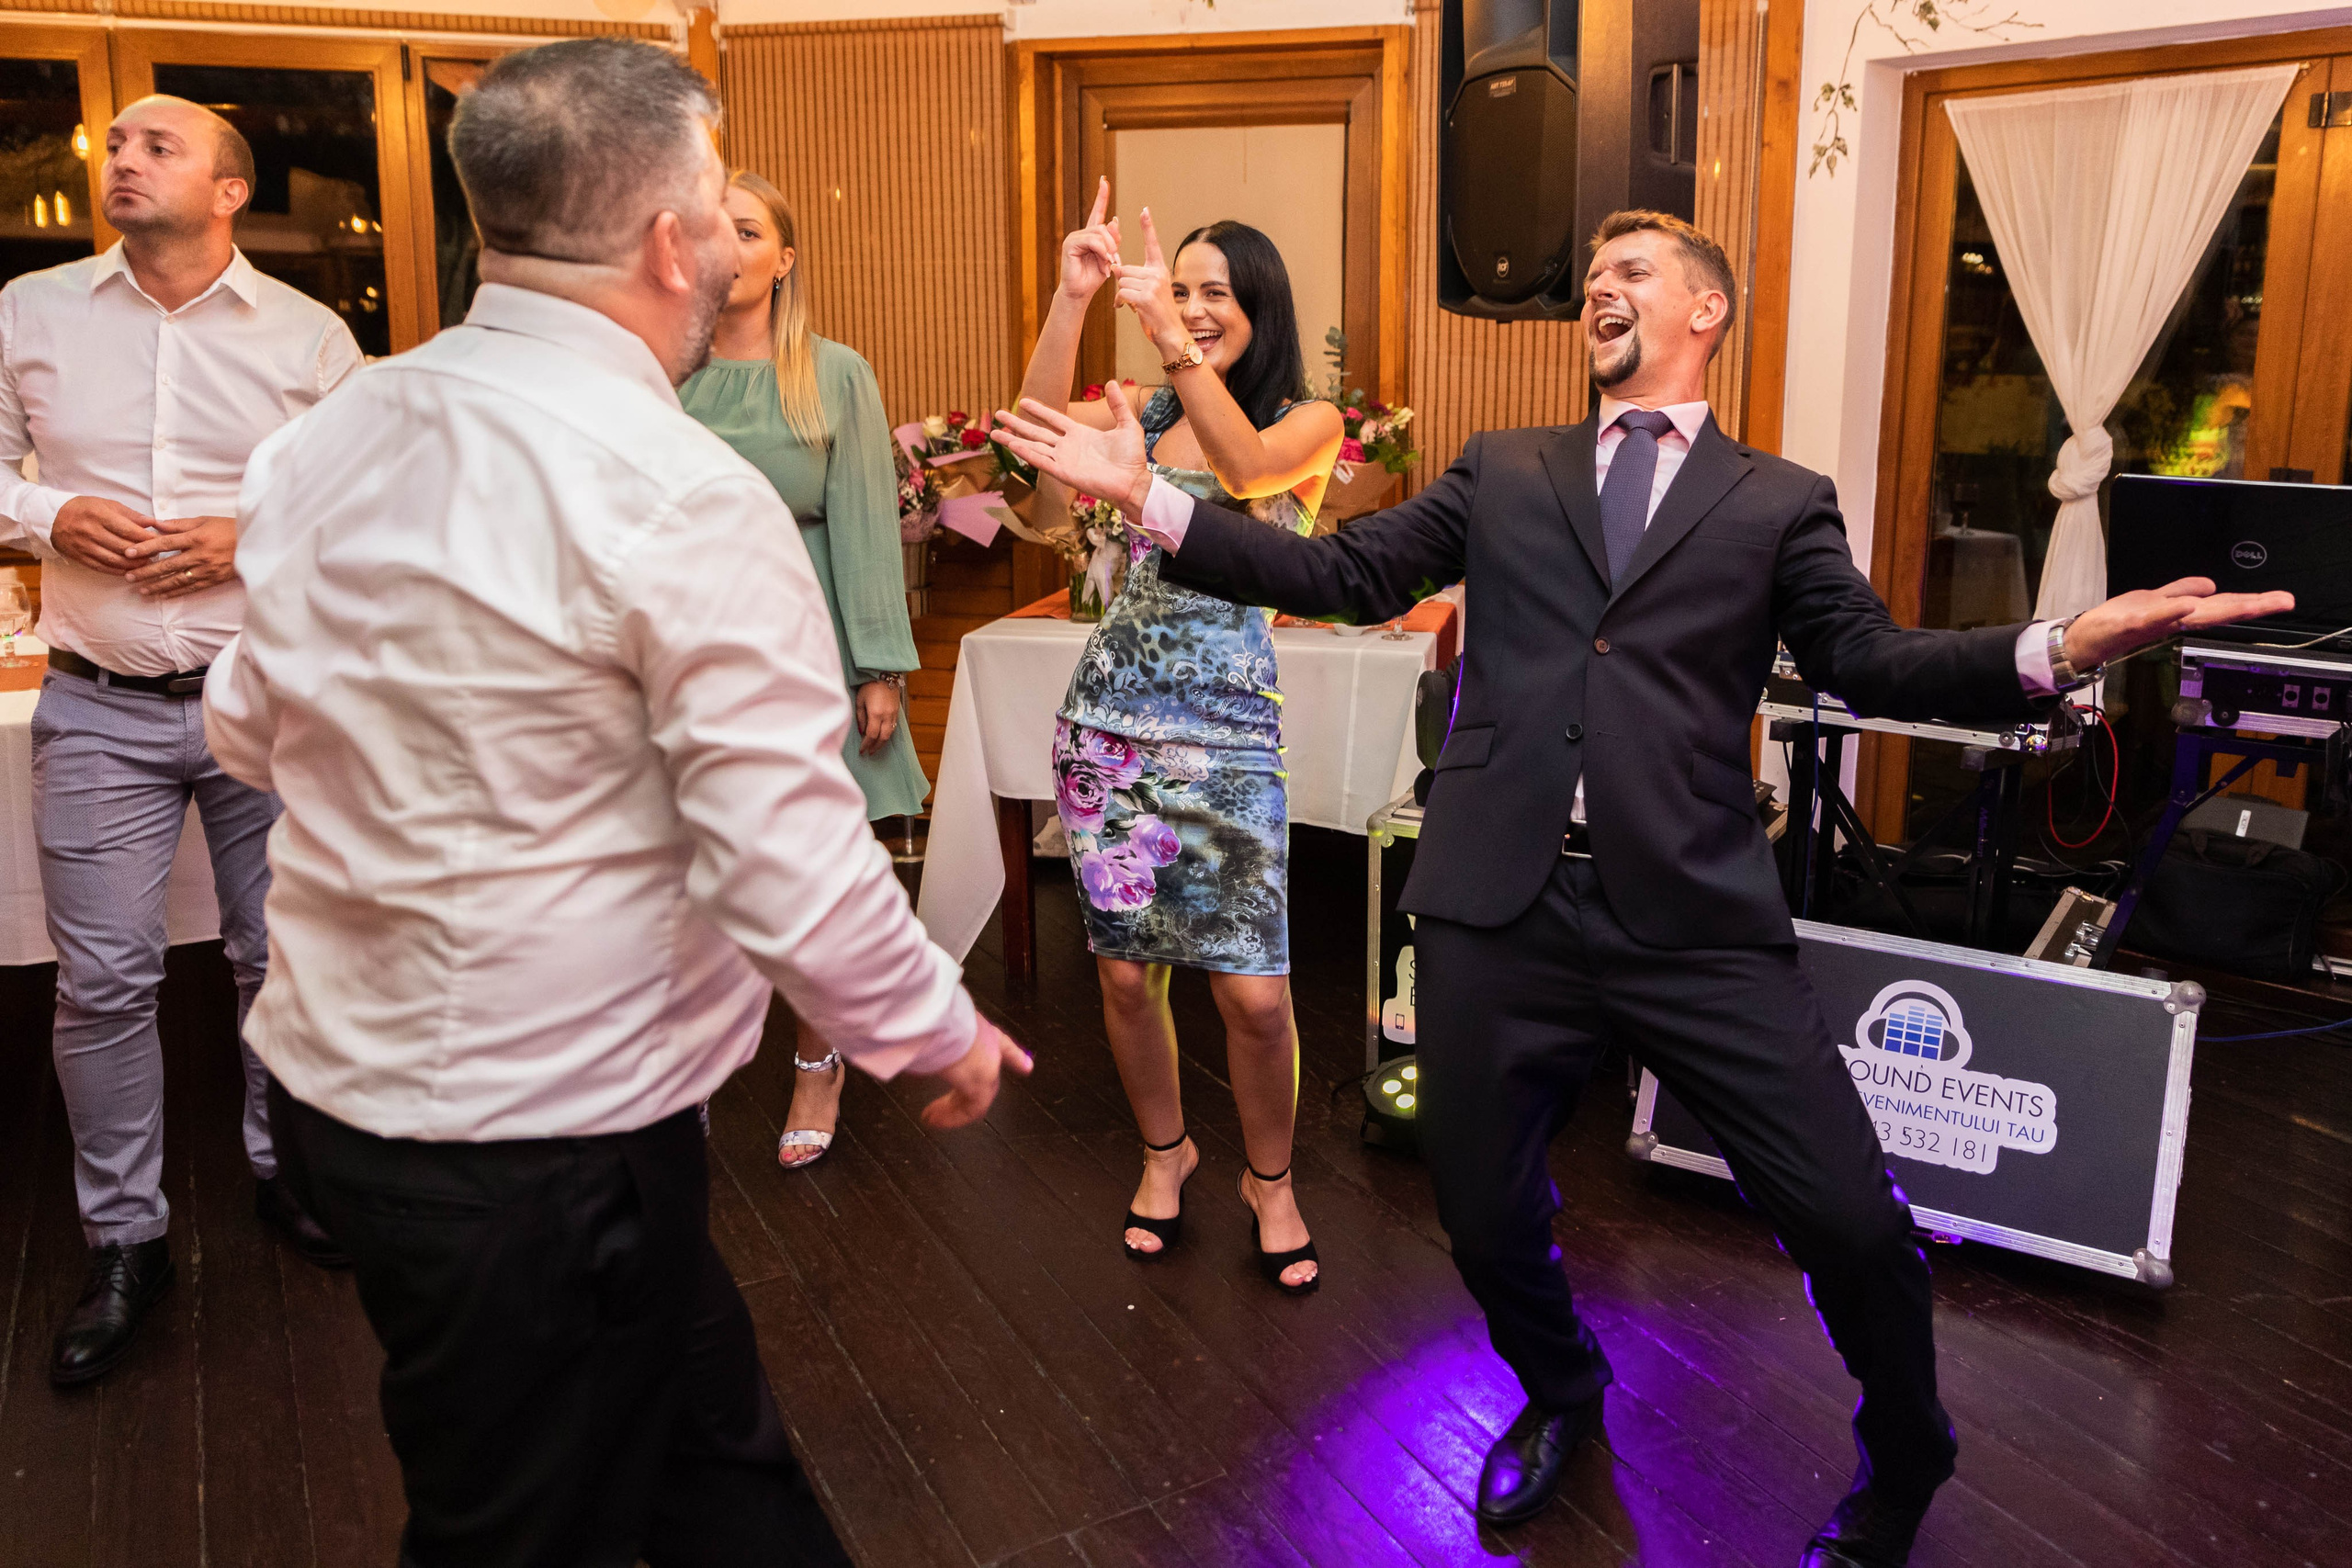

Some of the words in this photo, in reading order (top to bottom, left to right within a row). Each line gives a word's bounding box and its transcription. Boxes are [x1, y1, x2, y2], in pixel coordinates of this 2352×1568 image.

[2234, 550, 2263, 559] DELL
[1849, 1059, 1932, 1093] OUND
[1941, 1077, 2043, 1118] EVENTS
[1858, 1090, 2000, 1134] VENIMENTULUI
[2007, 1122, 2045, 1144] TAU
[1899, 1126, 1940, 1153] 532
[1952, 1137, 1986, 1163] 181
